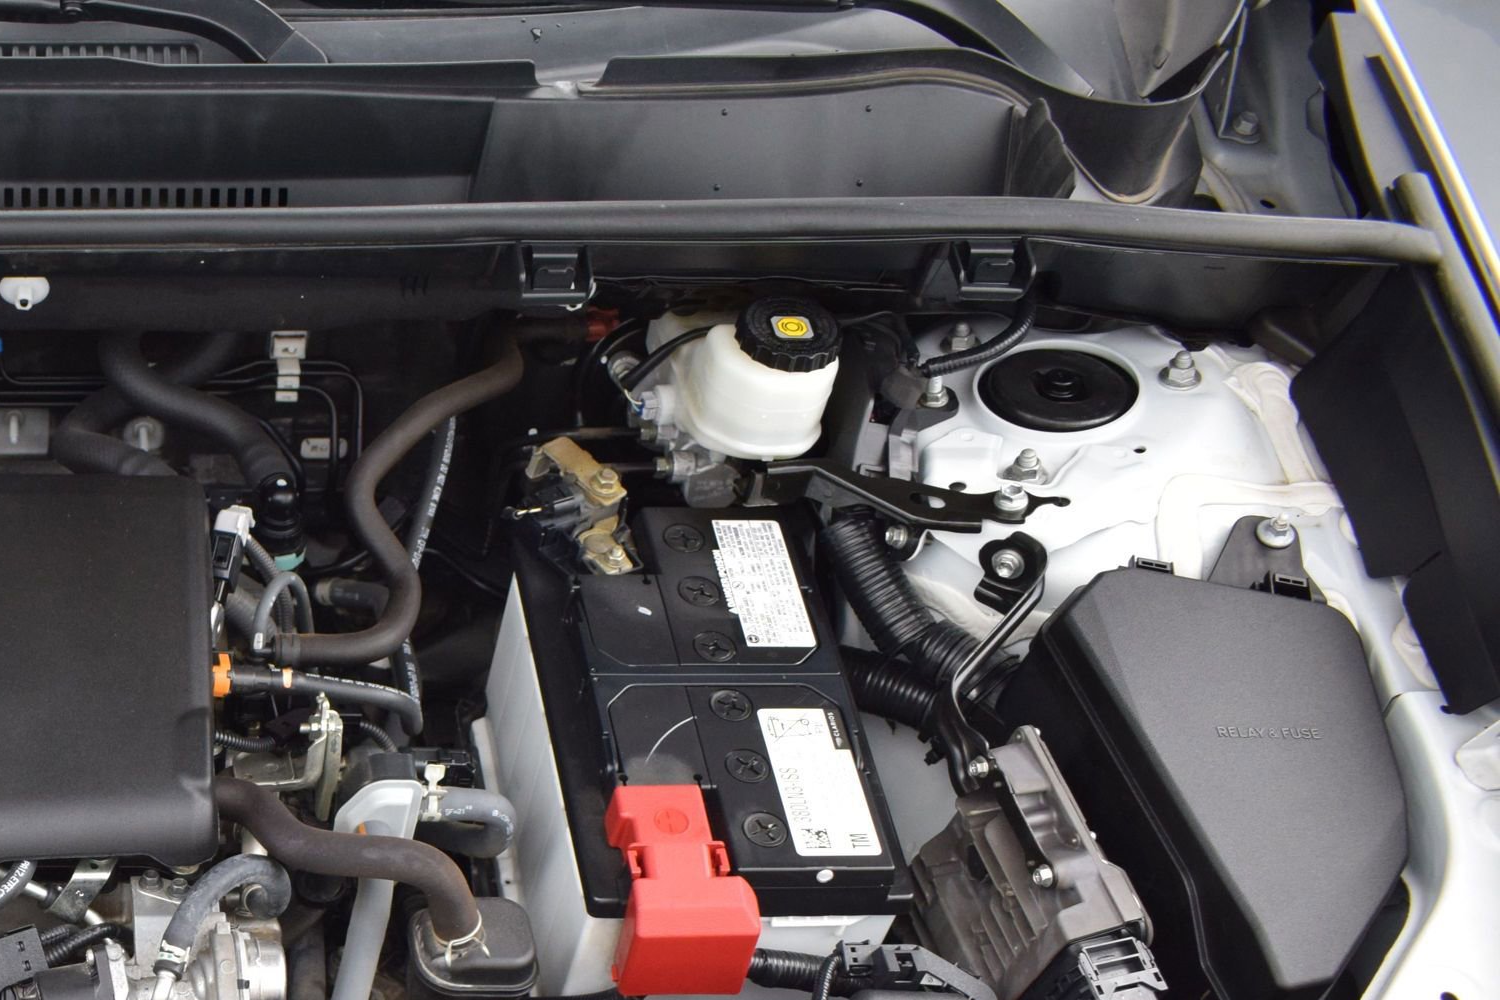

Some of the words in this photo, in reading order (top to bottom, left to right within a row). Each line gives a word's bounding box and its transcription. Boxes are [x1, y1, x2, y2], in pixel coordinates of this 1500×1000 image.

[827, 711, 840, 737] CLARIOS
[1215, 725, 1264, 738] RELAY
[1268, 728, 1279, 738] &
[1280, 727, 1324, 740] FUSE
[849, 833, 872, 849] TM
